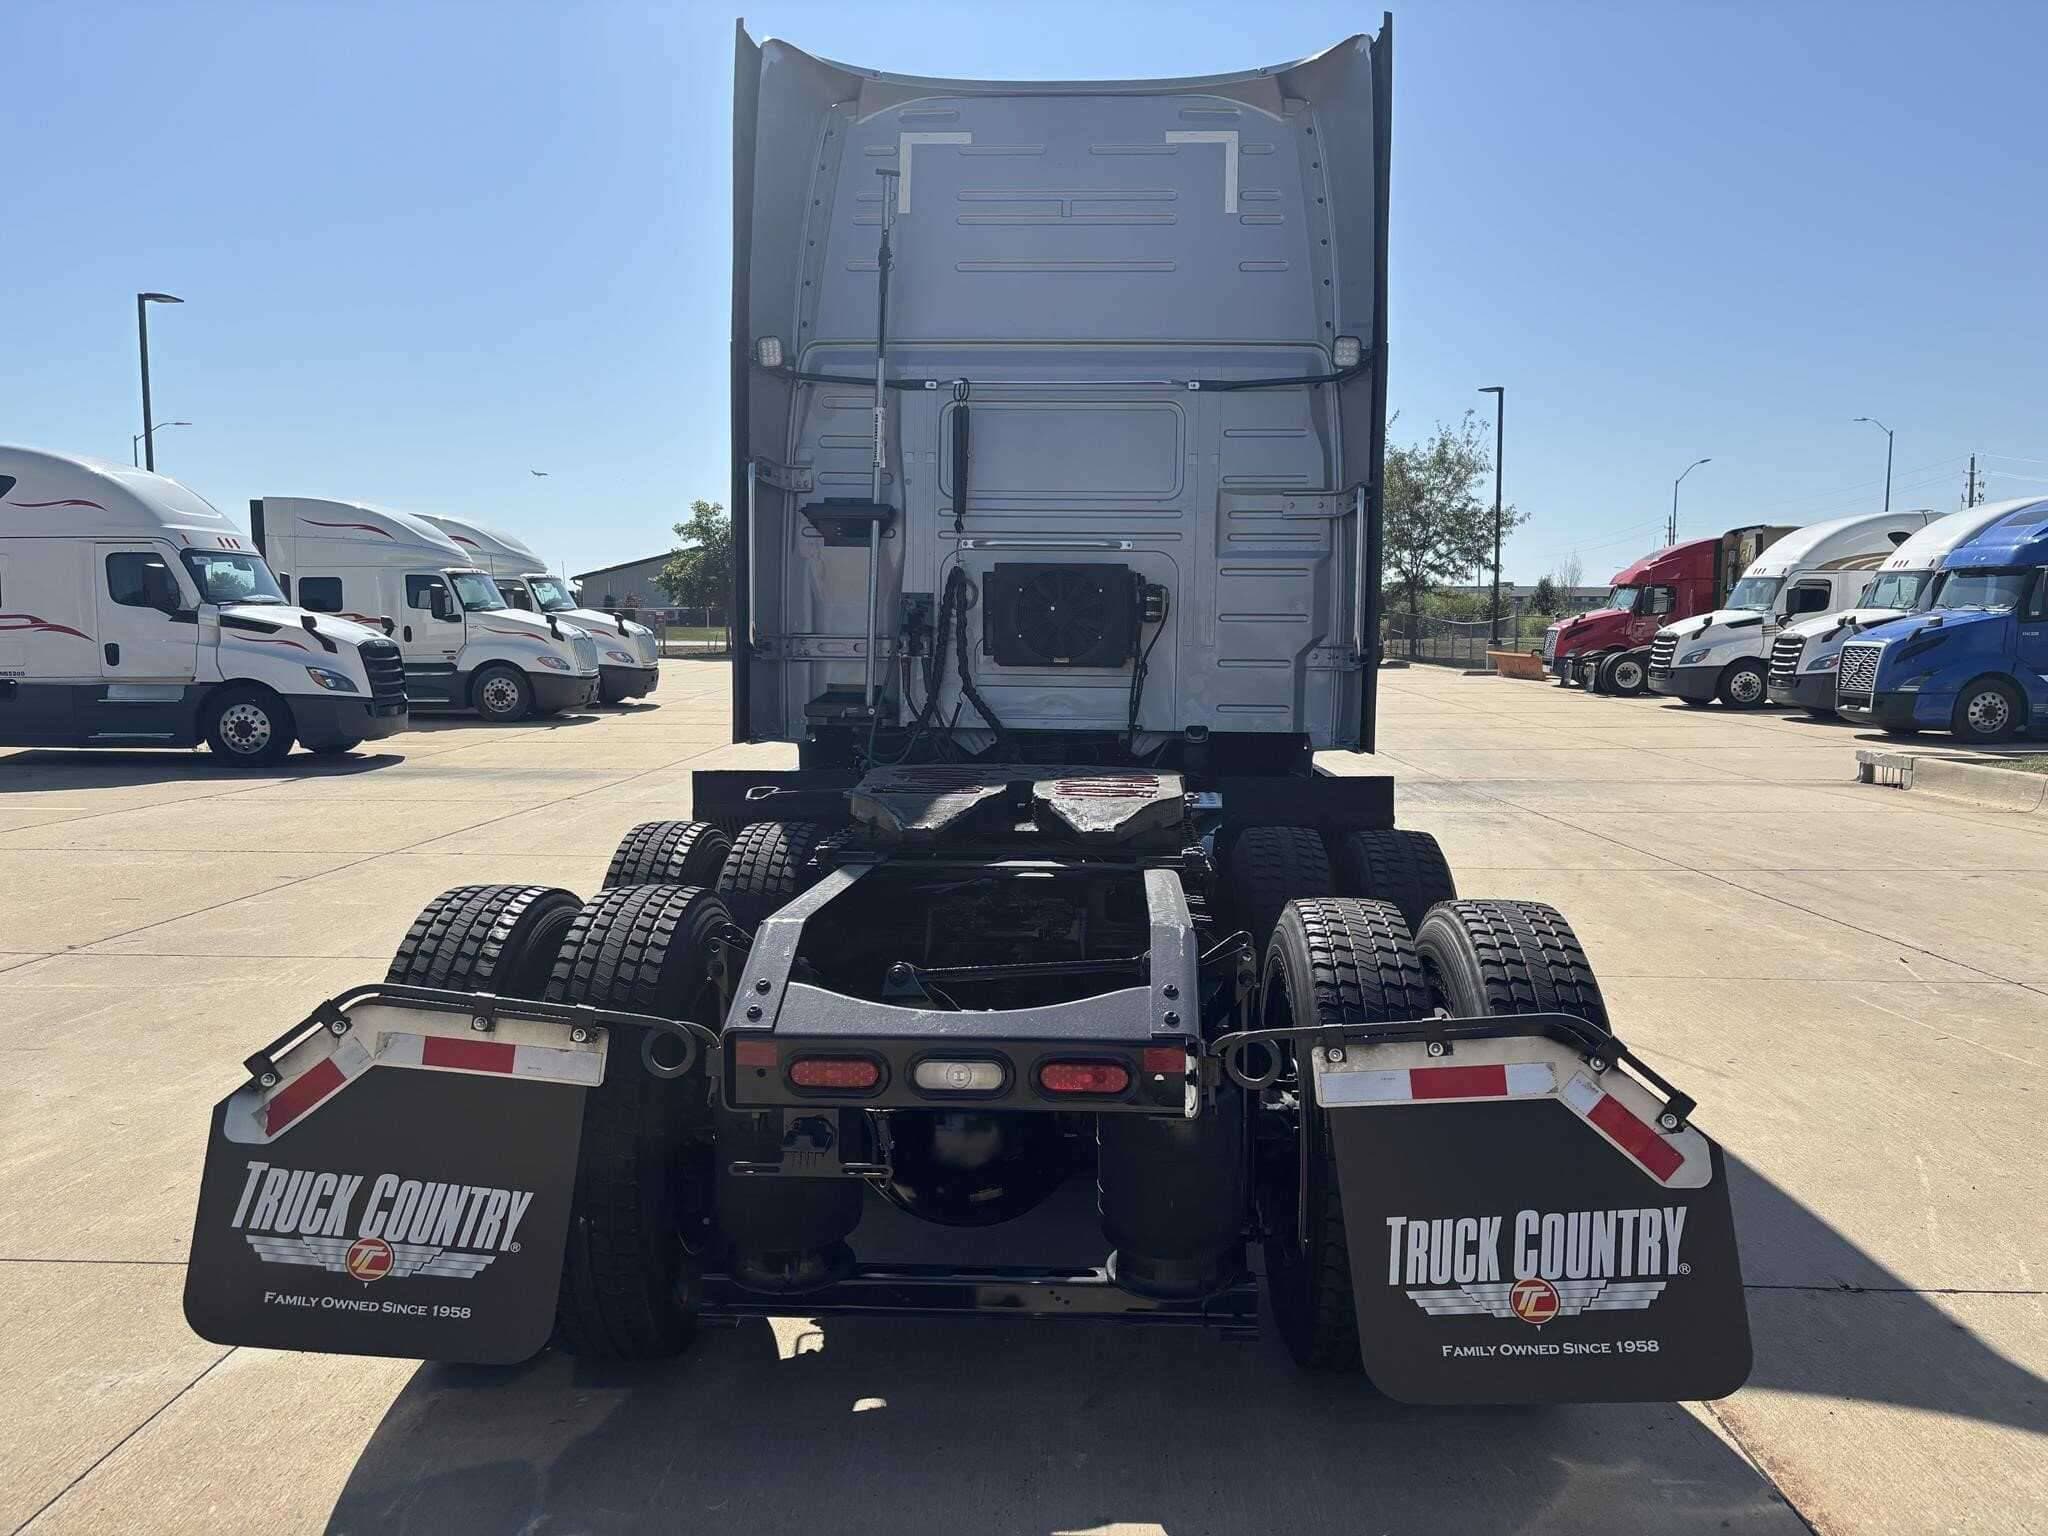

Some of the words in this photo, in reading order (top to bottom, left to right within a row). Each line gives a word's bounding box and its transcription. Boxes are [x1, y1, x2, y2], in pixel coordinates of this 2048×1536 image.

[231, 1161, 364, 1237] TRUCK
[358, 1173, 534, 1251] COUNTRY
[1386, 1216, 1502, 1286] TRUCK
[1513, 1206, 1687, 1280] COUNTRY
[264, 1291, 319, 1308] FAMILY
[321, 1296, 380, 1312] OWNED
[381, 1301, 428, 1316] SINCE
[432, 1305, 472, 1319] 1958
[1442, 1345, 1497, 1357] FAMILY
[1499, 1343, 1560, 1356] OWNED
[1562, 1342, 1612, 1354] SINCE
[1616, 1340, 1660, 1353] 1958
